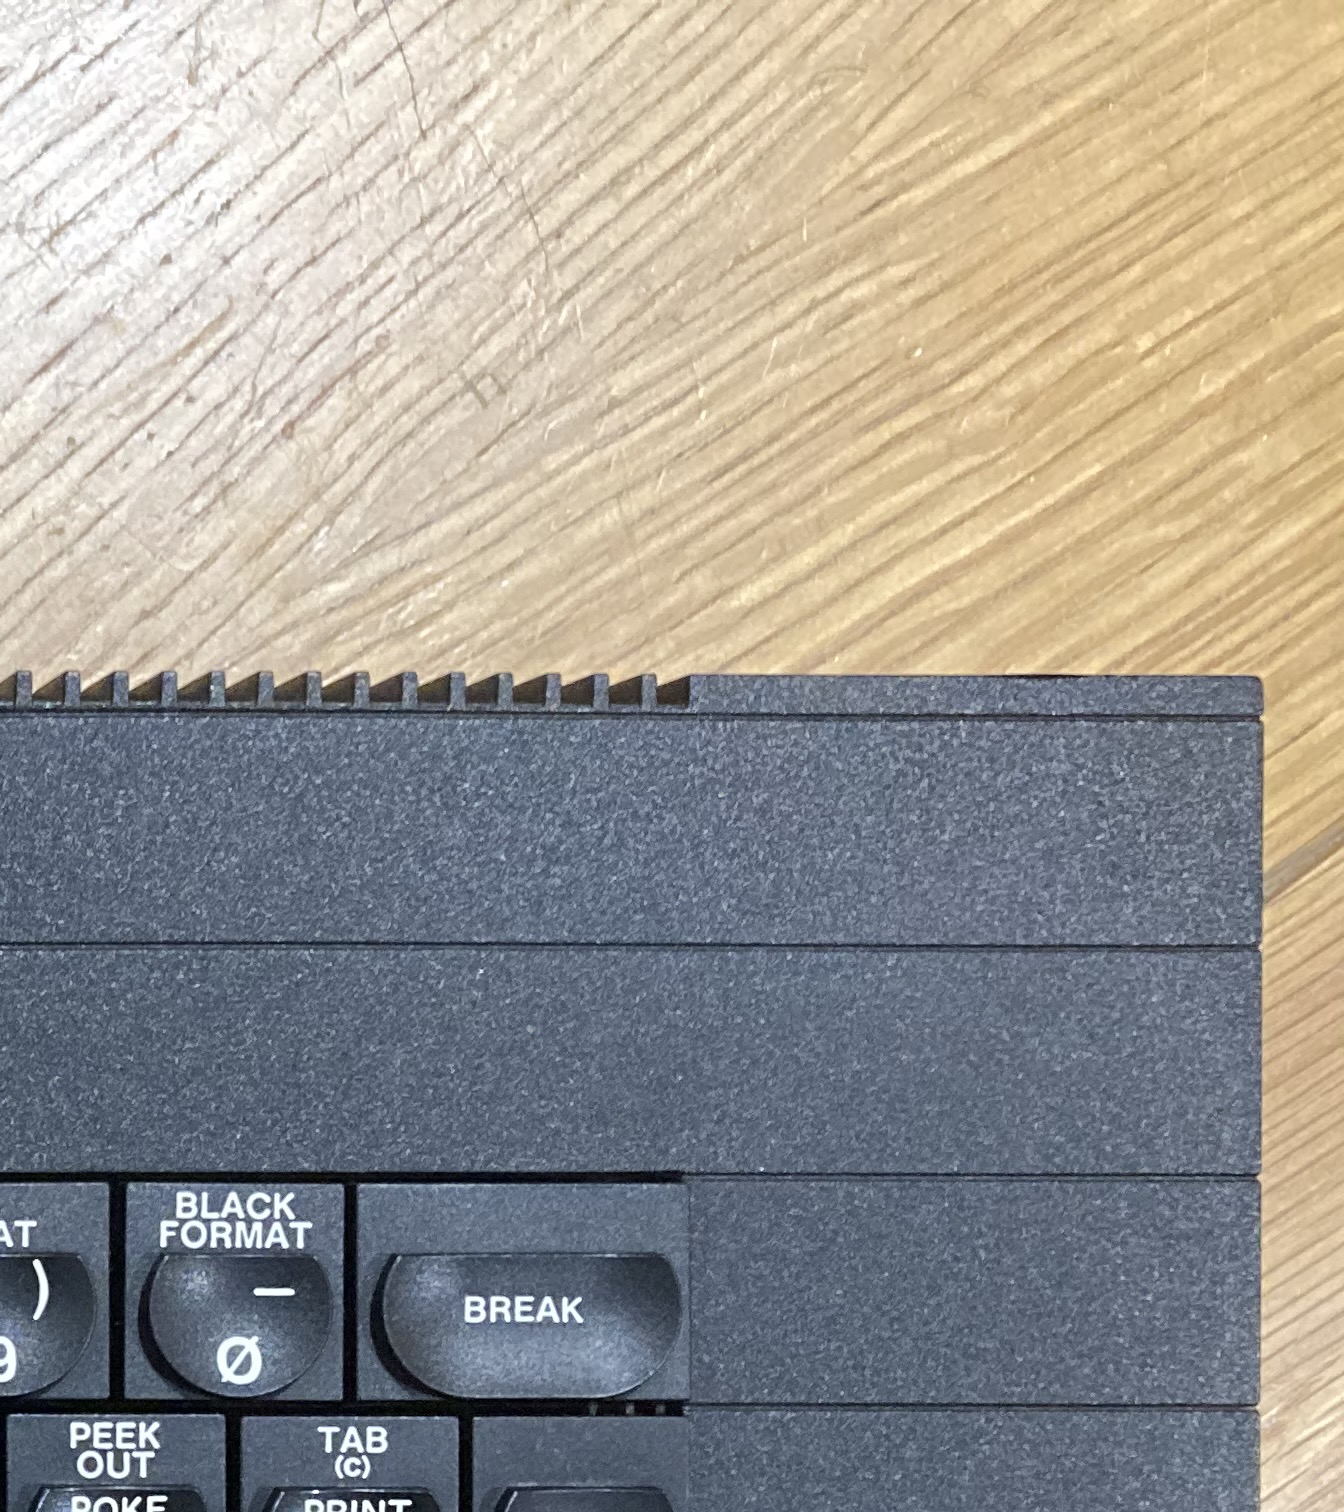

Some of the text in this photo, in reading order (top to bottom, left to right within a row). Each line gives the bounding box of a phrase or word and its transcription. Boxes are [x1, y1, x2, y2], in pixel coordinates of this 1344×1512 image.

[175, 1190, 296, 1221] BLACK
[159, 1219, 314, 1250] FORMAT
[463, 1294, 585, 1324] BREAK
[69, 1421, 161, 1451] PEEK
[316, 1425, 389, 1454] TAB
[76, 1450, 156, 1480] OUT
